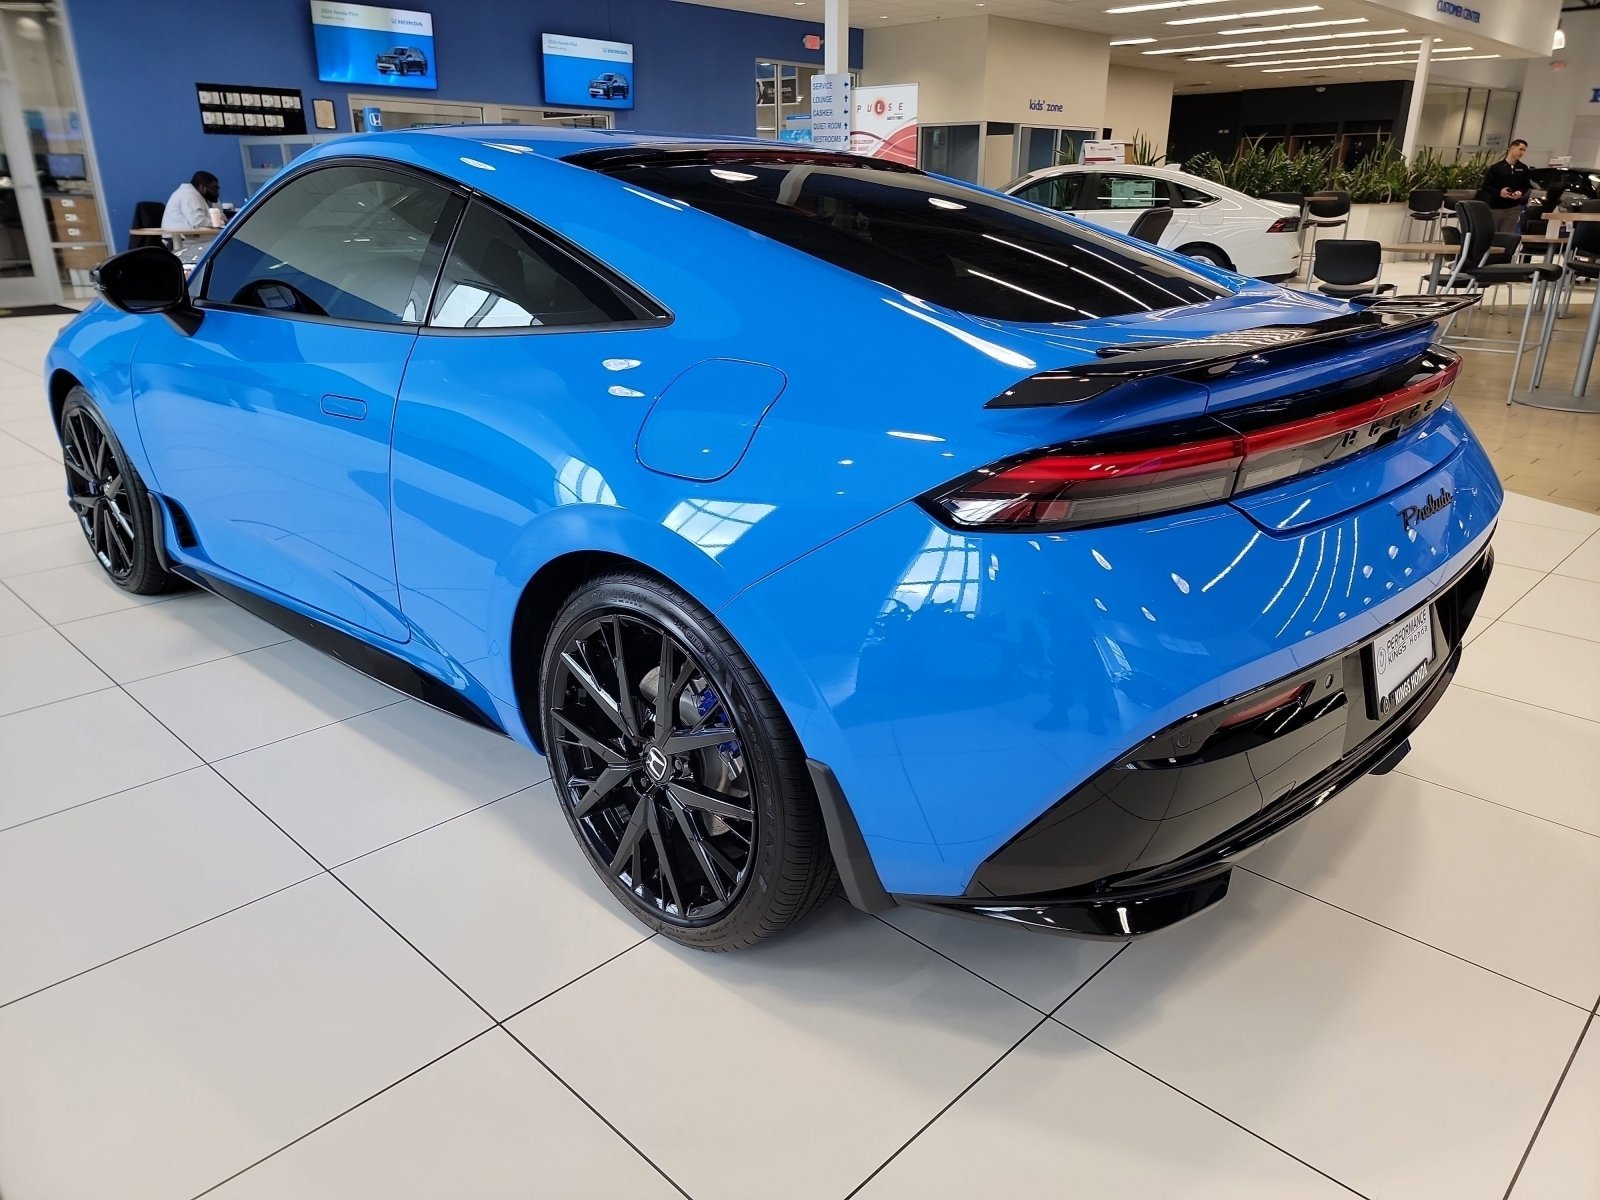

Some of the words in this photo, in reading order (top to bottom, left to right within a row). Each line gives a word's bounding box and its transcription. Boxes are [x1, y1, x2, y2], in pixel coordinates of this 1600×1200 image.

[1437, 0, 1462, 16] CUSTOMER
[1463, 8, 1480, 23] CENTER
[607, 48, 629, 56] HONDA
[812, 82, 833, 91] SERVICE
[812, 96, 833, 104] LOUNGE
[1029, 98, 1046, 111] kids'
[1046, 103, 1063, 112] zone
[812, 109, 833, 117] CASHIER
[812, 122, 827, 130] QUIET
[827, 121, 842, 129] ROOM
[813, 135, 842, 143] RESTROOMS
[1397, 488, 1453, 533] Prelude
[1386, 608, 1427, 651] PERFORMANCE
[1387, 642, 1407, 665] KINGS
[1394, 681, 1412, 706] KINGS
